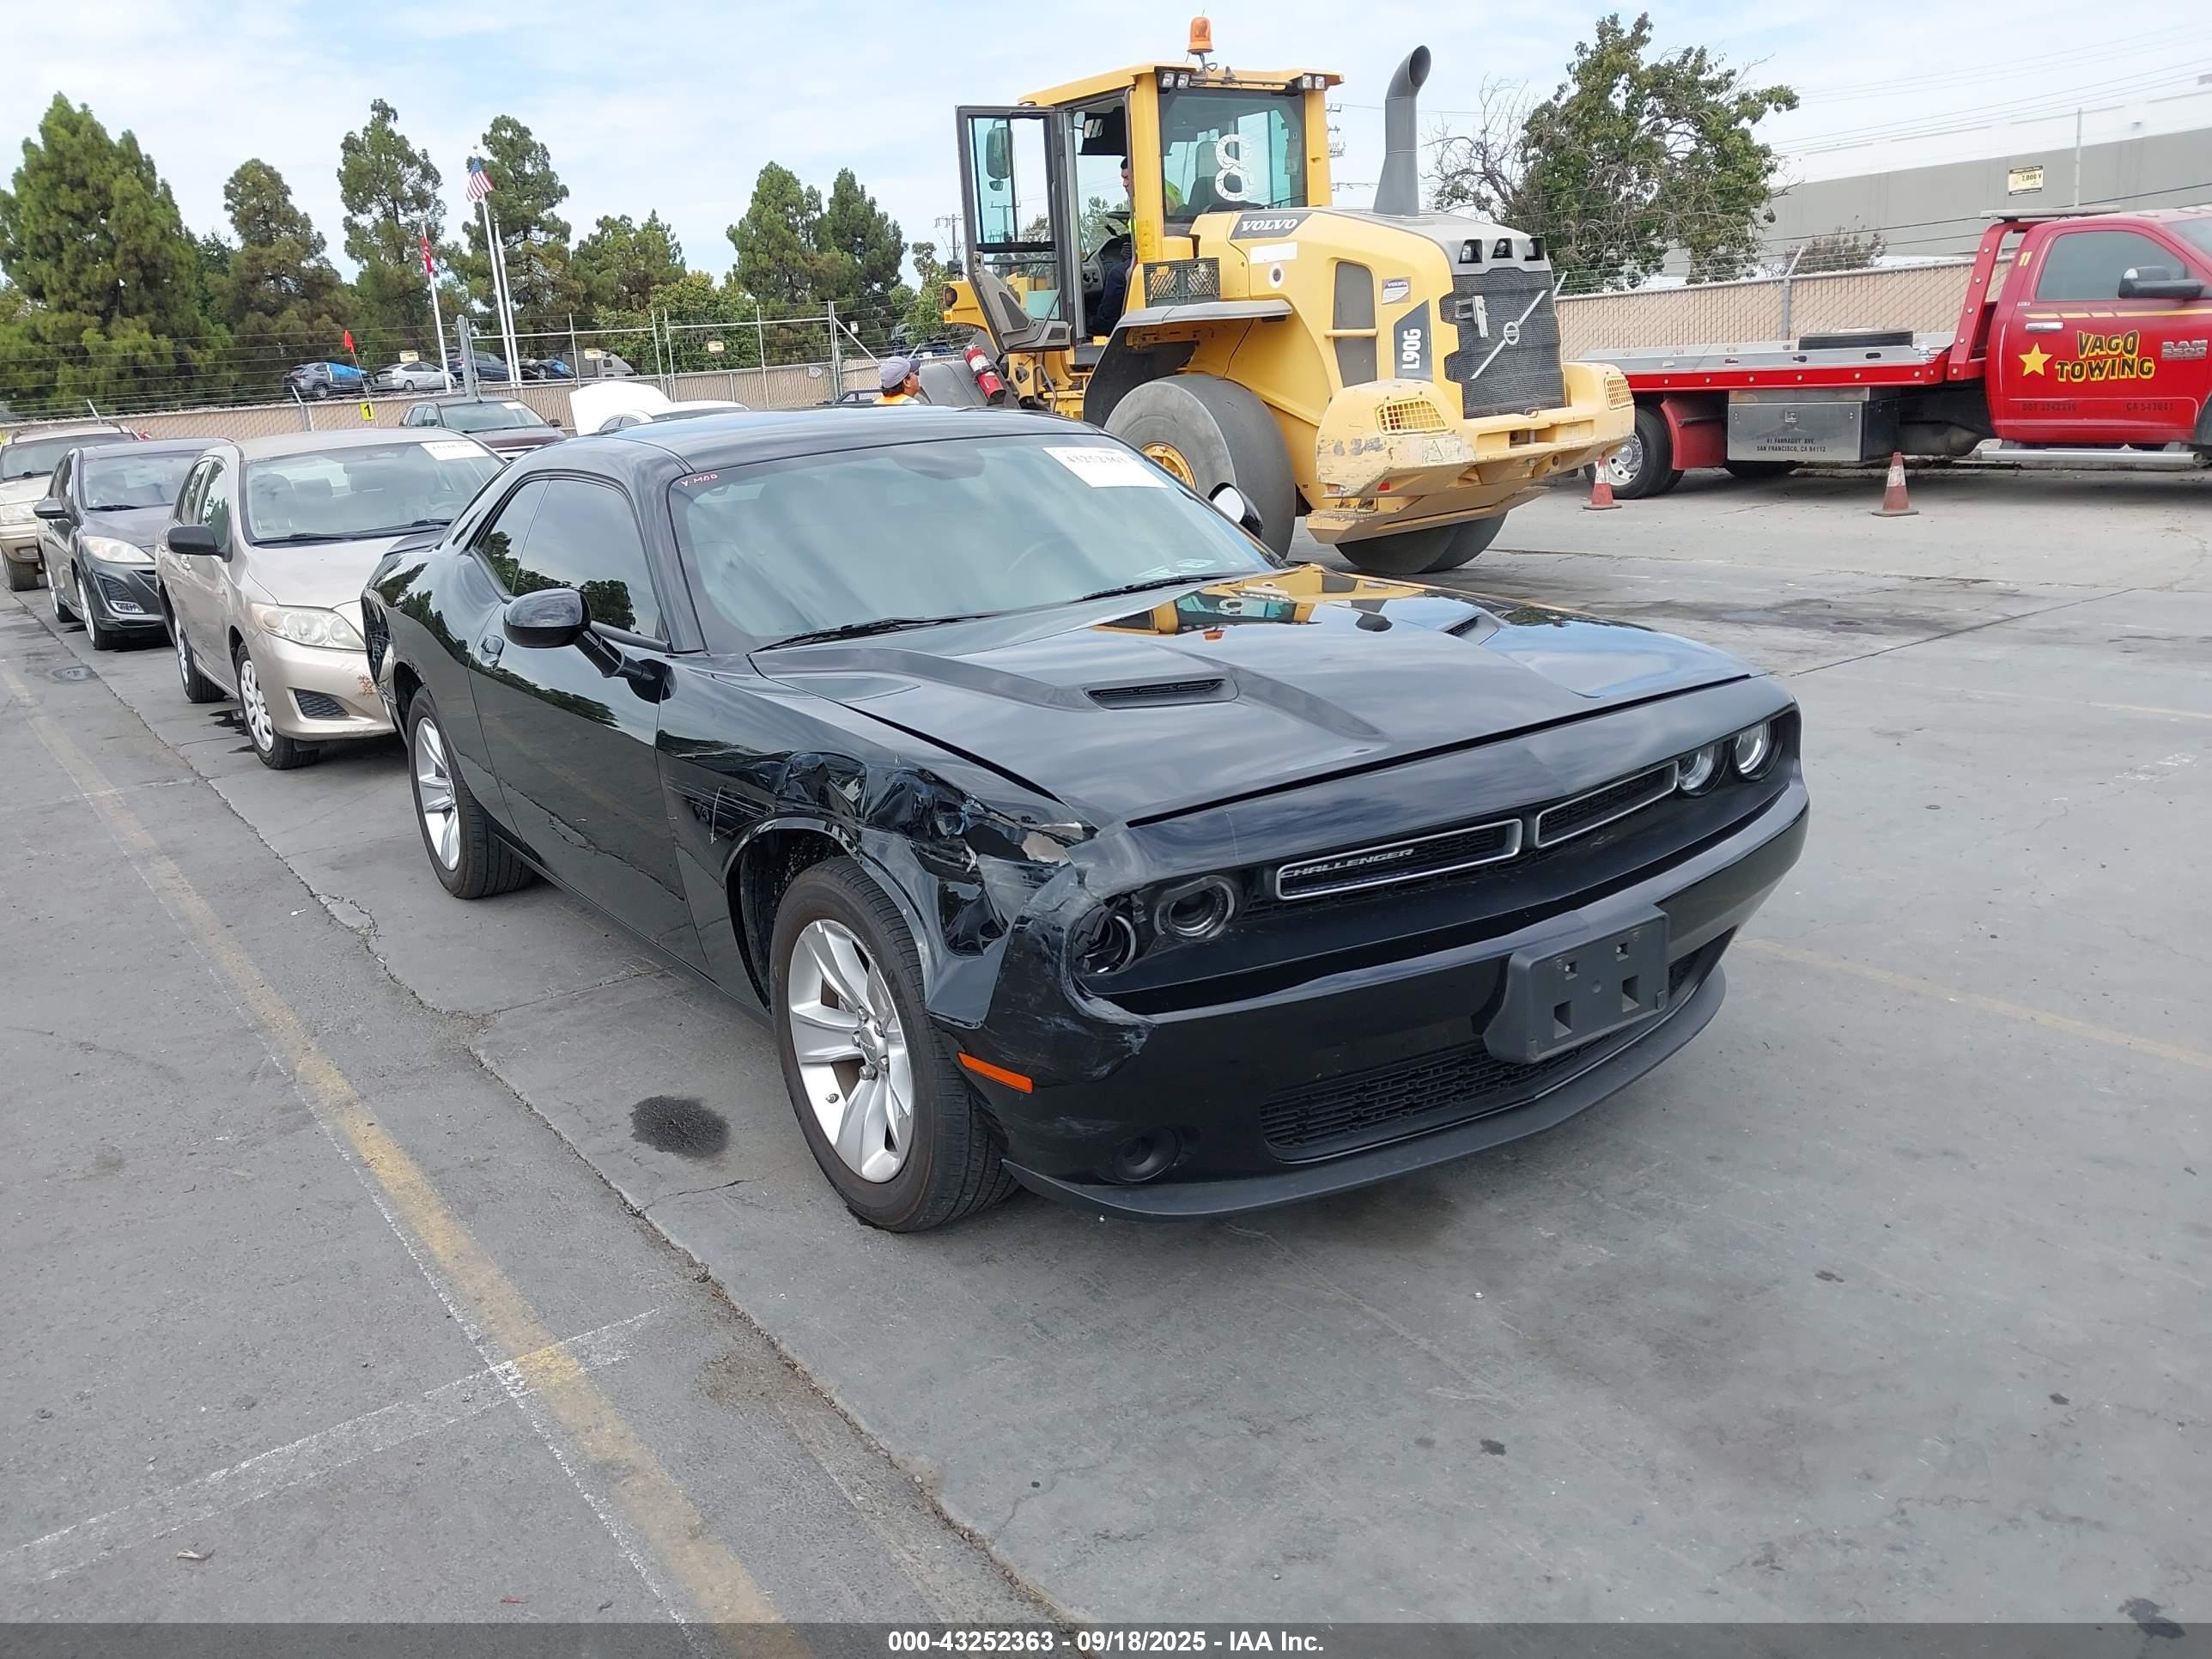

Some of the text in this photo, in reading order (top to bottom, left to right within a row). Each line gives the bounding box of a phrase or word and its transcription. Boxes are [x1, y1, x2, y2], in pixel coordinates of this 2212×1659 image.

[1215, 134, 1255, 202] 8
[1242, 219, 1298, 232] VOLVO
[1402, 329, 1422, 370] L90G
[2077, 330, 2141, 359] VAGO
[2161, 340, 2209, 349] RAM
[2055, 357, 2156, 383] TOWING
[363, 404, 372, 417] 1
[1279, 849, 1415, 878] CHALLENGER
